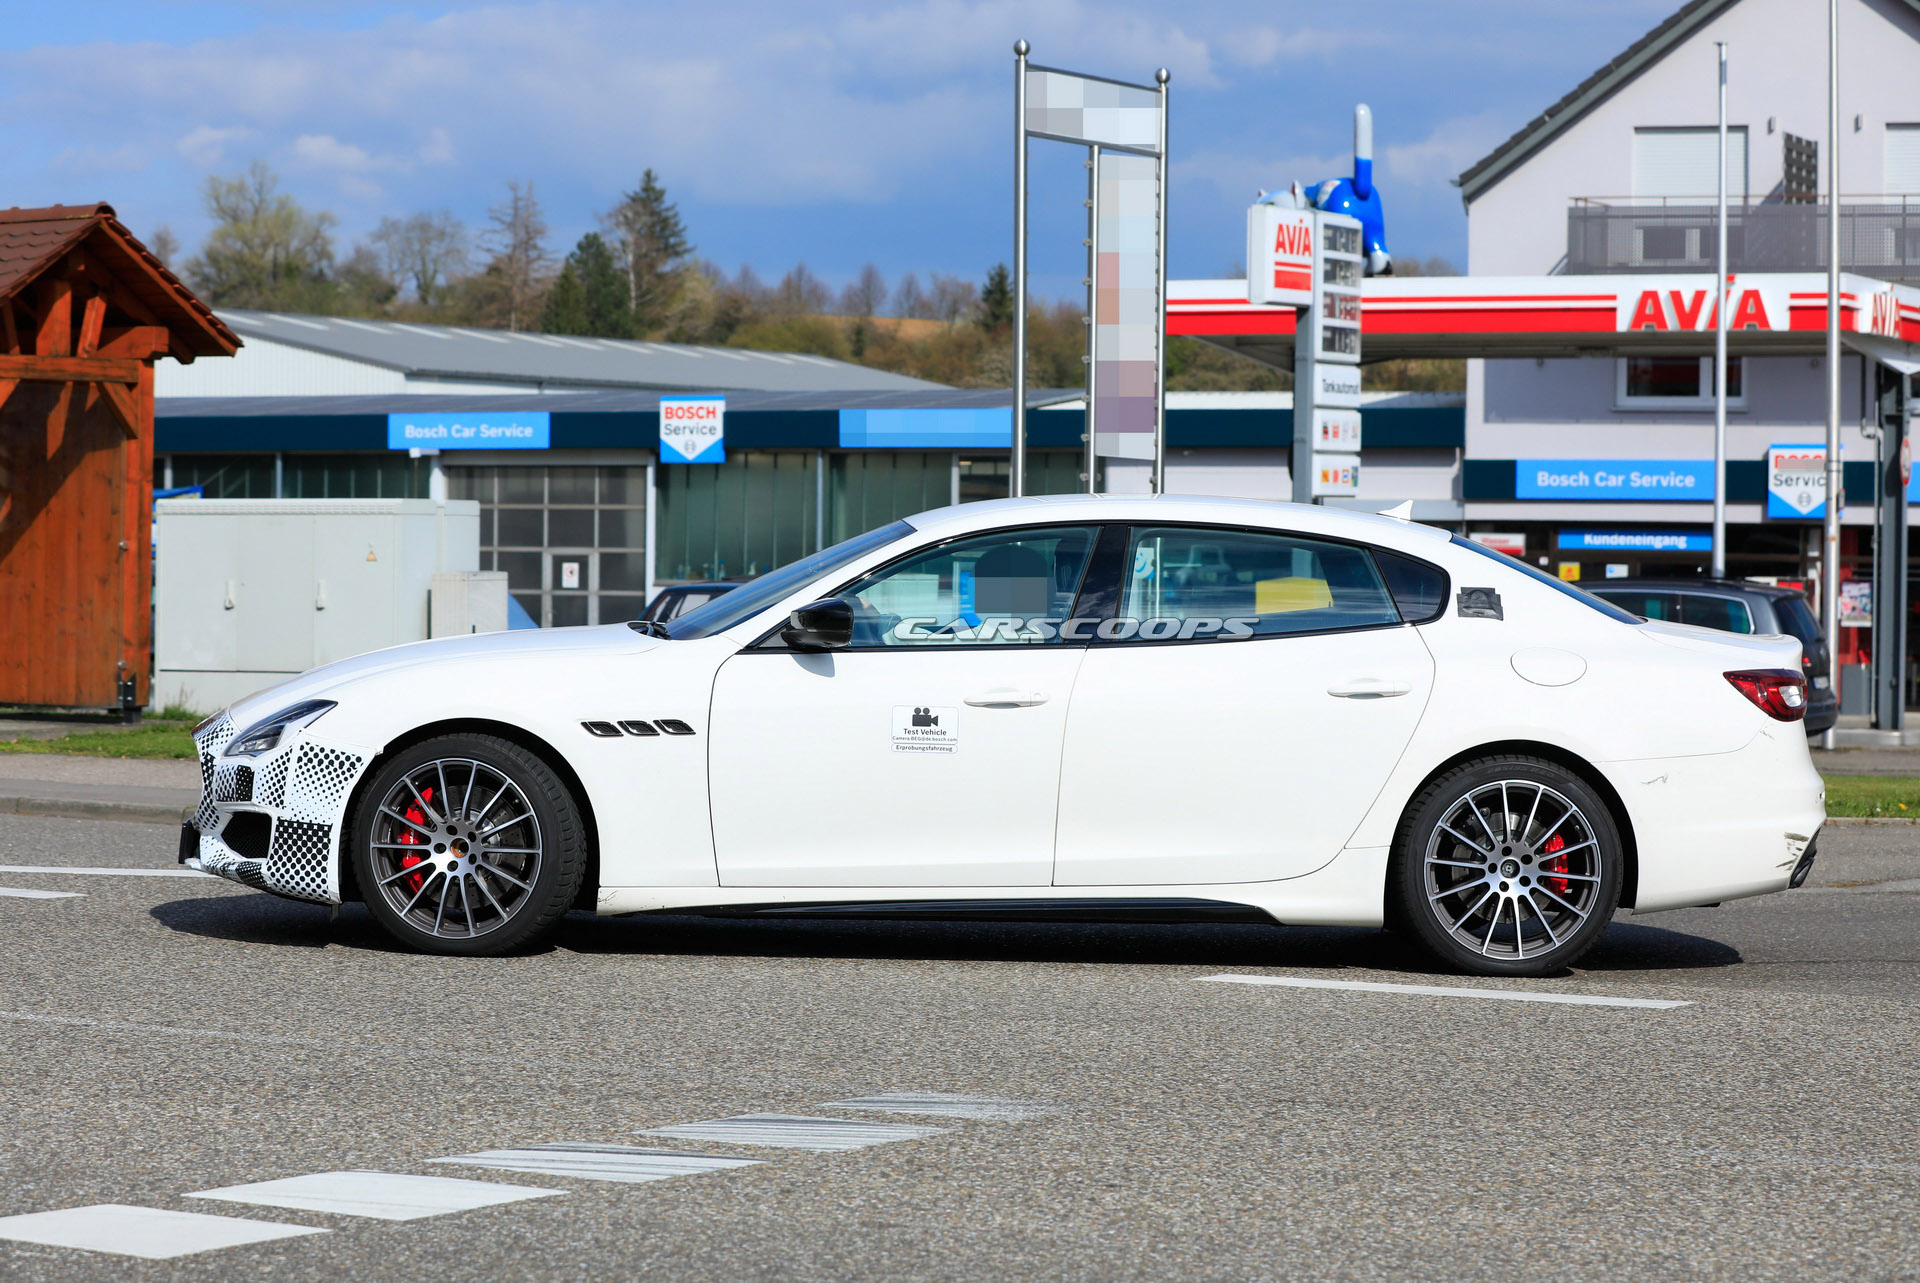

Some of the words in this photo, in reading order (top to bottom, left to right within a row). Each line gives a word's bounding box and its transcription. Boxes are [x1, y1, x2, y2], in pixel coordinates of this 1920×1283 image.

[664, 406, 717, 420] BOSCH
[405, 424, 448, 438] Bosch
[451, 424, 476, 438] Car
[480, 423, 534, 438] Service
[663, 422, 718, 436] Service
[1537, 471, 1590, 487] Bosch
[1594, 472, 1625, 487] Car
[1630, 471, 1696, 487] Service
[1773, 472, 1827, 487] Servic
[1584, 532, 1688, 549] Kundeneingang
[895, 744, 953, 752] Erprobungsfahrzeug
